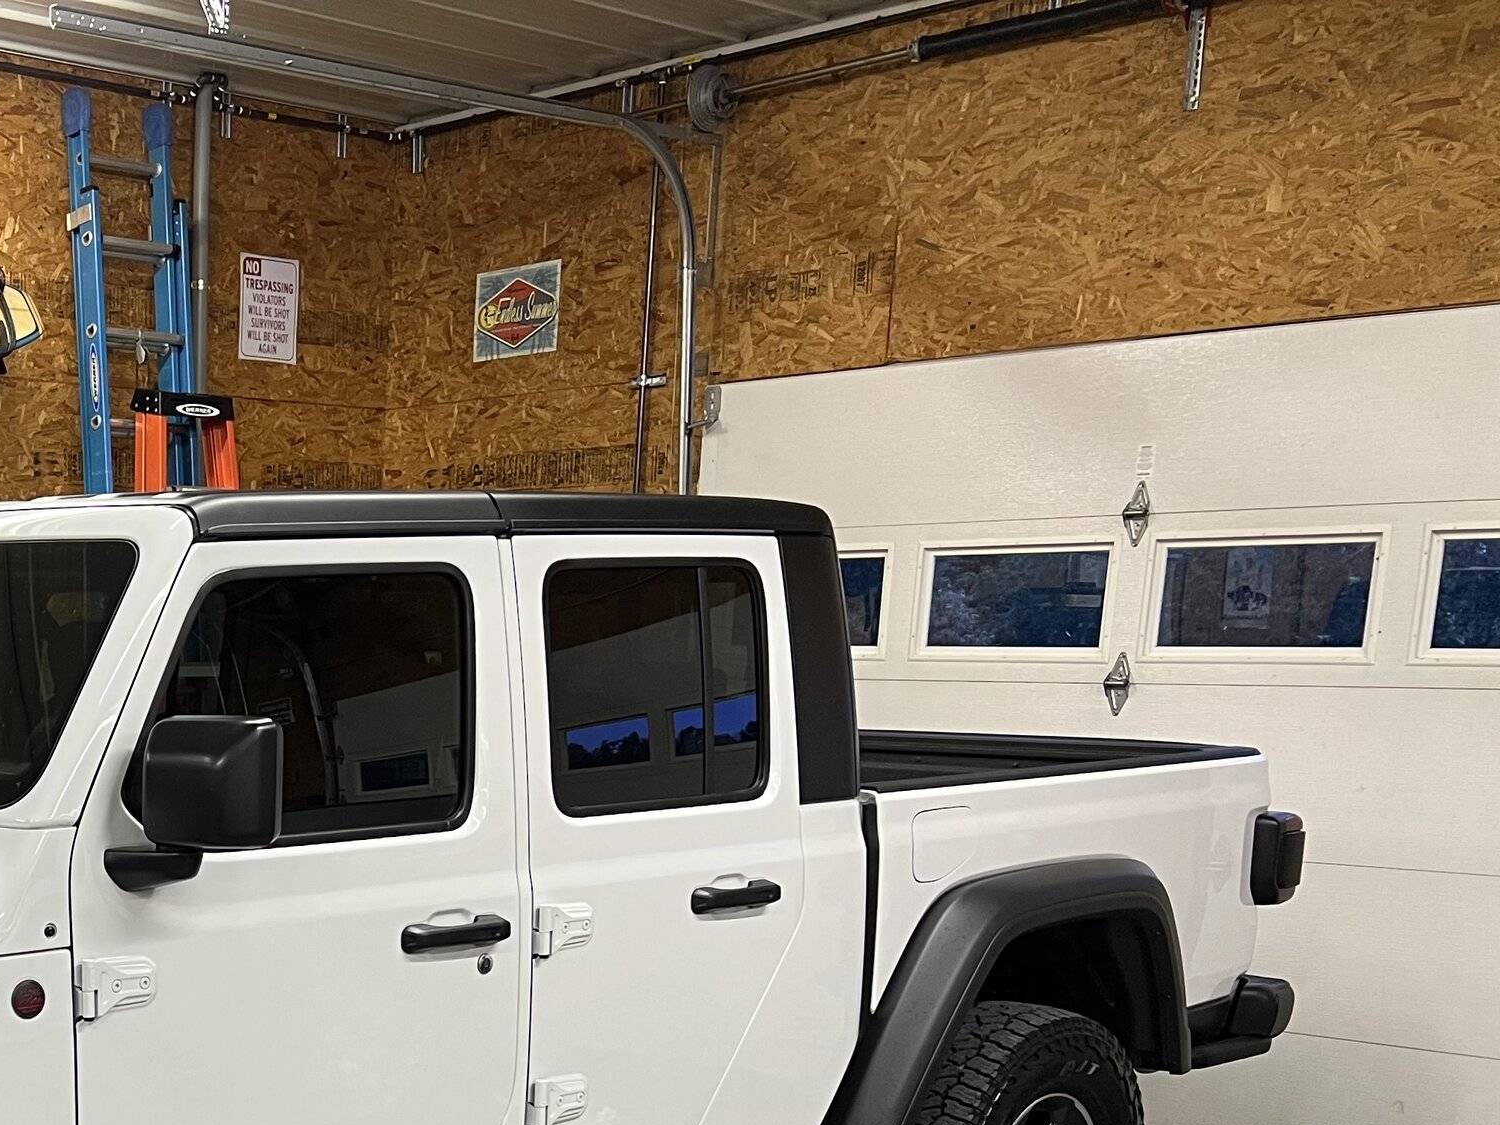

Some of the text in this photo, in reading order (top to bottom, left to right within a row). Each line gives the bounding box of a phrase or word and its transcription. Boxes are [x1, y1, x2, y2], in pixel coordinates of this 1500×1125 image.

[245, 260, 260, 274] NO
[245, 277, 294, 294] TRESPASSING
[252, 292, 286, 306] VIOLATORS
[248, 305, 289, 319] WILL BE SHOT
[251, 318, 286, 331] SURVIVORS
[247, 330, 289, 344] WILL BE SHOT
[258, 343, 277, 354] AGAIN
